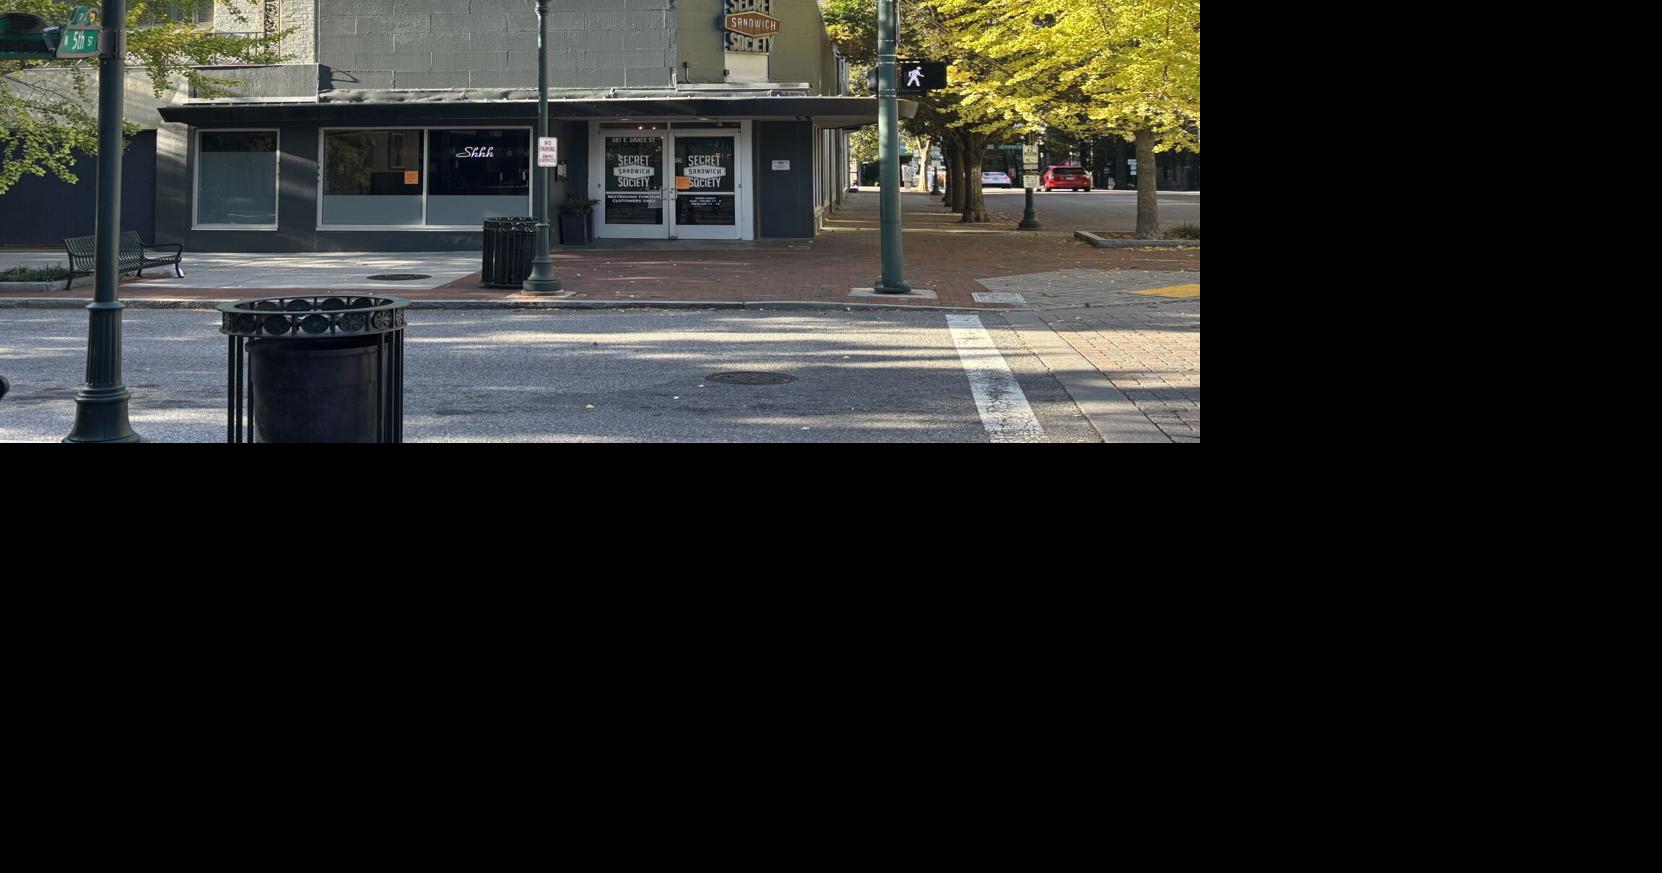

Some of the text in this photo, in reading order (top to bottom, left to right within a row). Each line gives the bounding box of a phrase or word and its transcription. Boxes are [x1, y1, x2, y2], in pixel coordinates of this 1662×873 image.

[731, 17, 776, 31] SANDWICH
[64, 30, 94, 50] N 5th ST
[730, 32, 775, 53] SOCIETY
[455, 146, 494, 158] Shhh
[618, 154, 650, 166] SECRET
[688, 154, 721, 166] SECRET
[618, 176, 650, 187] SOCIETY
[688, 176, 721, 188] SOCIETY
